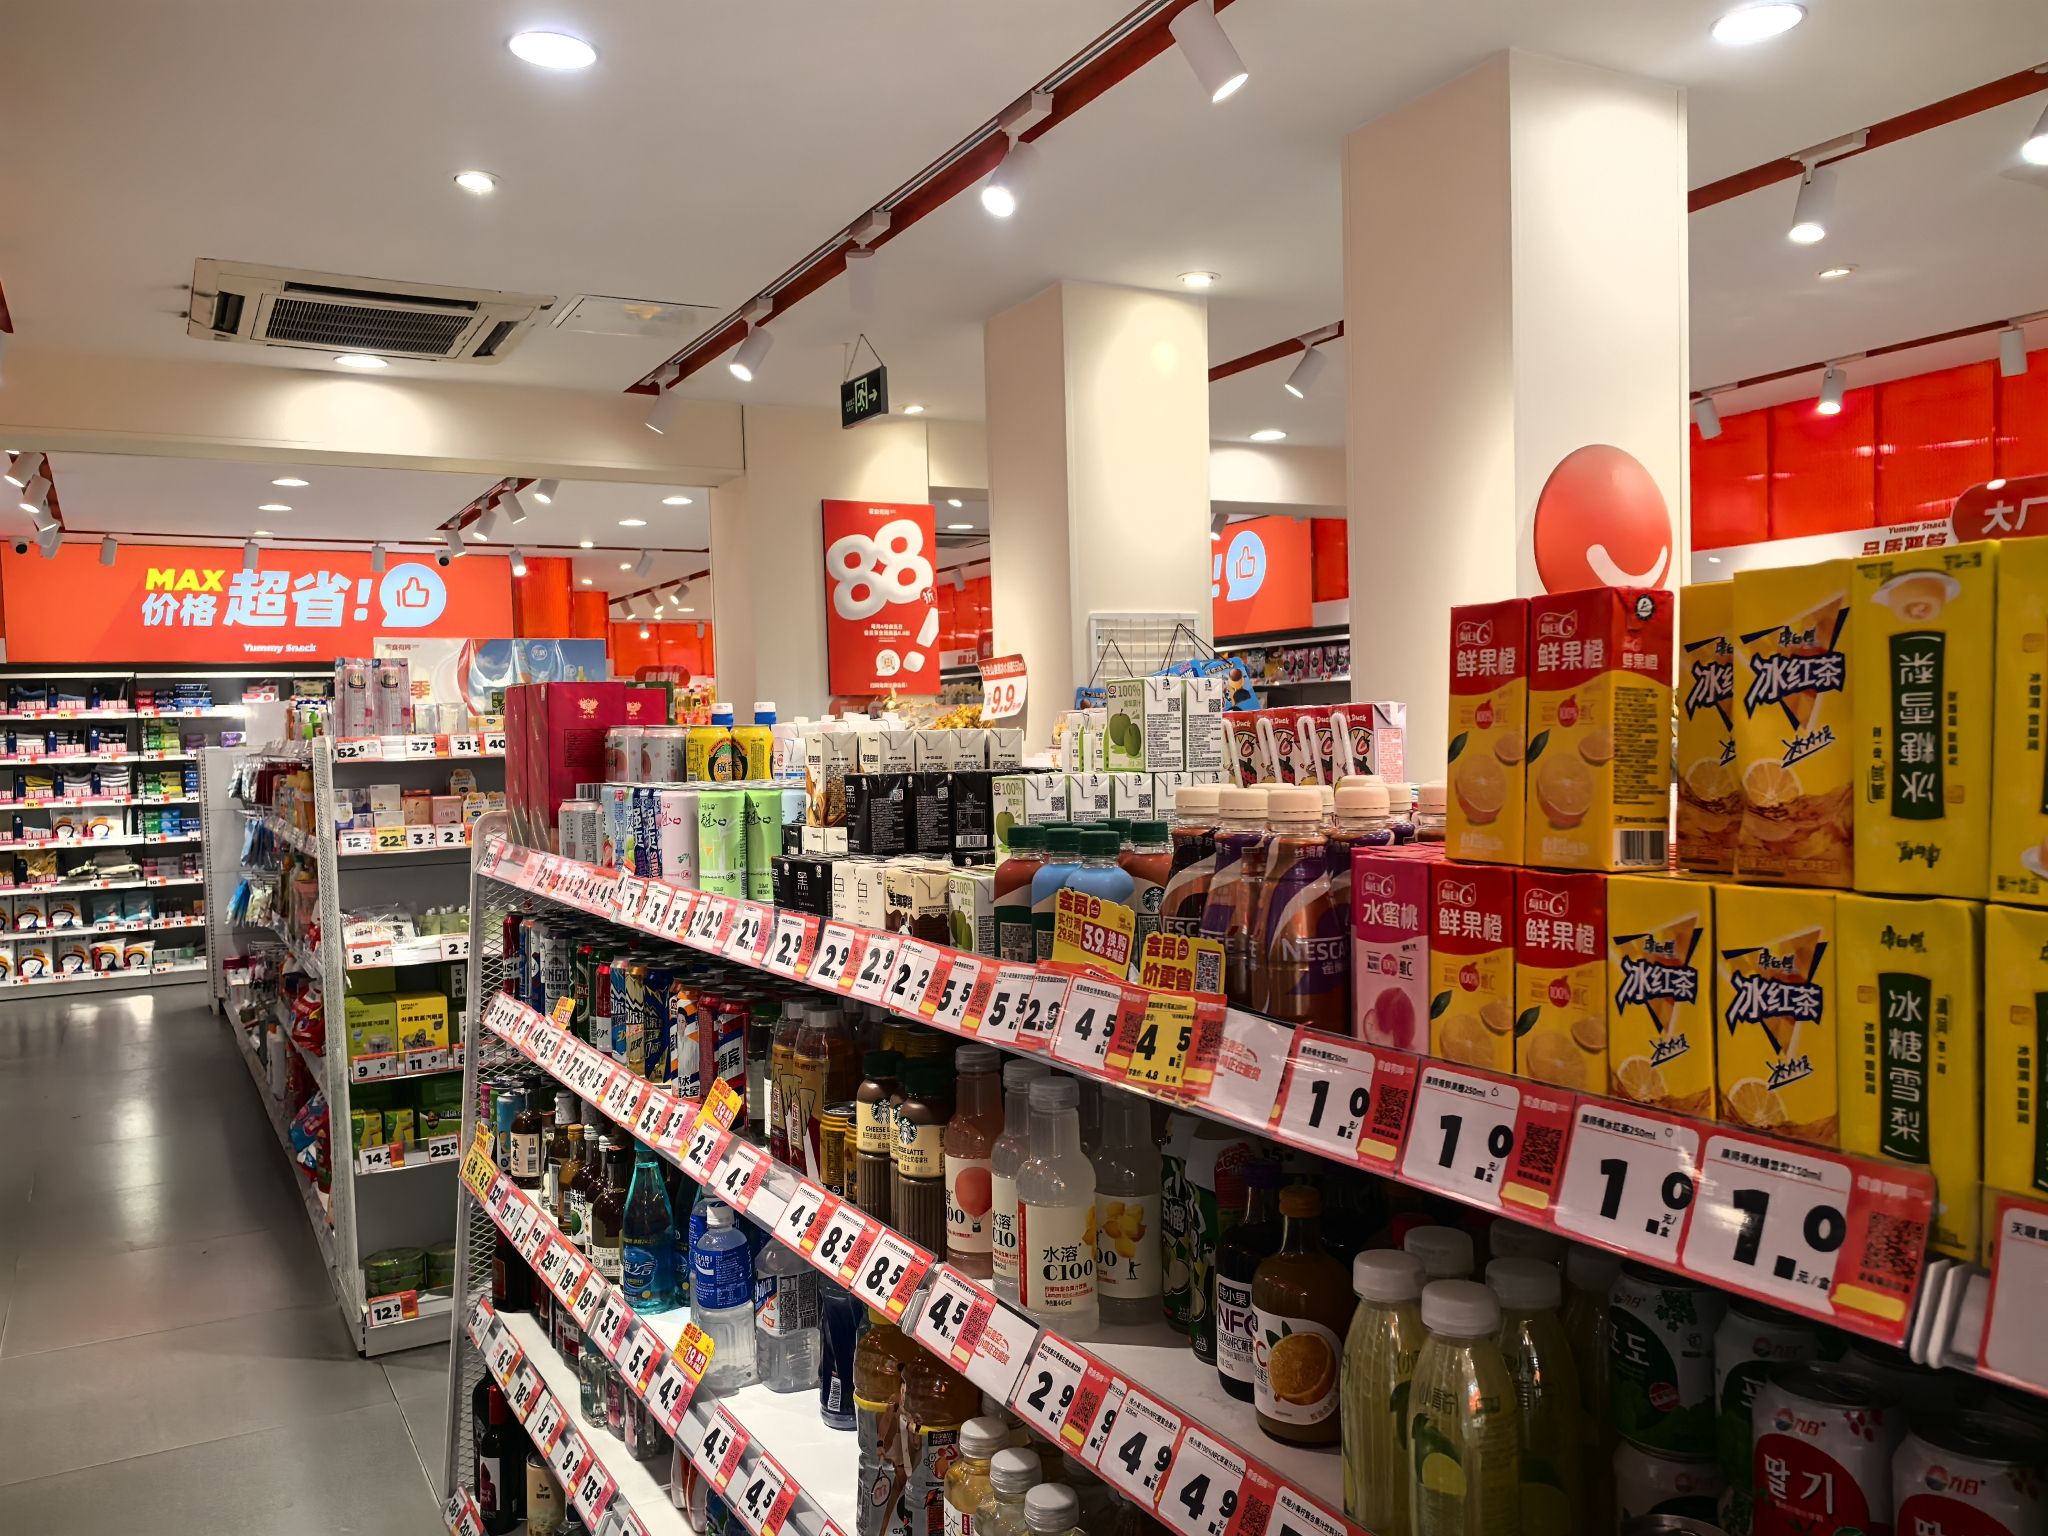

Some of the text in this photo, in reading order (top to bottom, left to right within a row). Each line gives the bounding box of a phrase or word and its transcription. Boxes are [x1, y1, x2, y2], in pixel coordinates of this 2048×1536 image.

[1889, 520, 1947, 534] Yummy Snack
[145, 568, 224, 591] MAX
[141, 570, 370, 627] 价格 超省!
[243, 643, 317, 654] Yummy Snack
[1456, 647, 1516, 677] 鲜果橙
[1537, 639, 1605, 672] 鲜果橙
[1622, 653, 1658, 670] 鲜果橙
[1117, 684, 1141, 697] 100%
[1750, 653, 1843, 702] 冰红茶
[991, 684, 1015, 714] 9.9
[1900, 652, 1935, 803] 冰糖雪梨
[337, 745, 365, 758] 62.6
[411, 741, 437, 754] 37.9
[457, 740, 480, 753] 31.5
[1002, 782, 1023, 795] 100%
[443, 831, 466, 844] 2.5
[701, 910, 723, 938] 2.0
[1362, 899, 1419, 931] 水蜜桃
[1438, 908, 1503, 944] 鲜果橙
[736, 918, 759, 950] 2.0
[776, 932, 802, 965] 2.9
[1525, 918, 1596, 955] 鲜果橙
[353, 950, 381, 965] 8.9
[820, 944, 850, 979] 2.9
[861, 948, 894, 985] 2.9
[891, 963, 930, 1002] 2.2
[937, 979, 973, 1017] 5.5
[1620, 961, 1697, 1003] 冰红茶
[1730, 975, 1821, 1021] 冰红茶
[988, 992, 1029, 1030] 5.5
[1075, 1007, 1117, 1054] 4.5
[1136, 1024, 1192, 1066] 4.5
[358, 1062, 386, 1077] 9.9
[409, 1056, 437, 1070] 11.9
[1145, 1070, 1158, 1080] 4.8
[1888, 990, 1923, 1142] 冰糖雪梨
[1308, 1079, 1370, 1137] 1.0
[1581, 1114, 1657, 1140] 康师傅冰红茶250ml
[431, 1142, 457, 1157] 25.8
[689, 1135, 714, 1166] 2.5
[1439, 1114, 1514, 1181] 1.0
[726, 1168, 751, 1197] 4.9
[1600, 1158, 1694, 1235] 1.0
[790, 1205, 817, 1239] 4.9
[992, 1227, 1016, 1248] C10
[1733, 1188, 1846, 1281] 1.0
[821, 1226, 857, 1264] 8.5
[1043, 1245, 1078, 1263] 水溶
[866, 1256, 904, 1297] 8.5
[1043, 1259, 1093, 1281] C100
[374, 1304, 400, 1320] 12.9
[1219, 1285, 1247, 1306] 纯小果
[600, 1308, 619, 1340] 3.8
[928, 1292, 969, 1338] 4.5
[659, 1376, 681, 1413] 4.9
[1027, 1371, 1075, 1422] 2.9
[703, 1427, 727, 1467] 4.5
[1119, 1431, 1172, 1487] 4.9
[745, 1478, 775, 1520] 4.5
[1763, 1453, 1834, 1516] 딸기
[1180, 1473, 1238, 1534] 4.9
